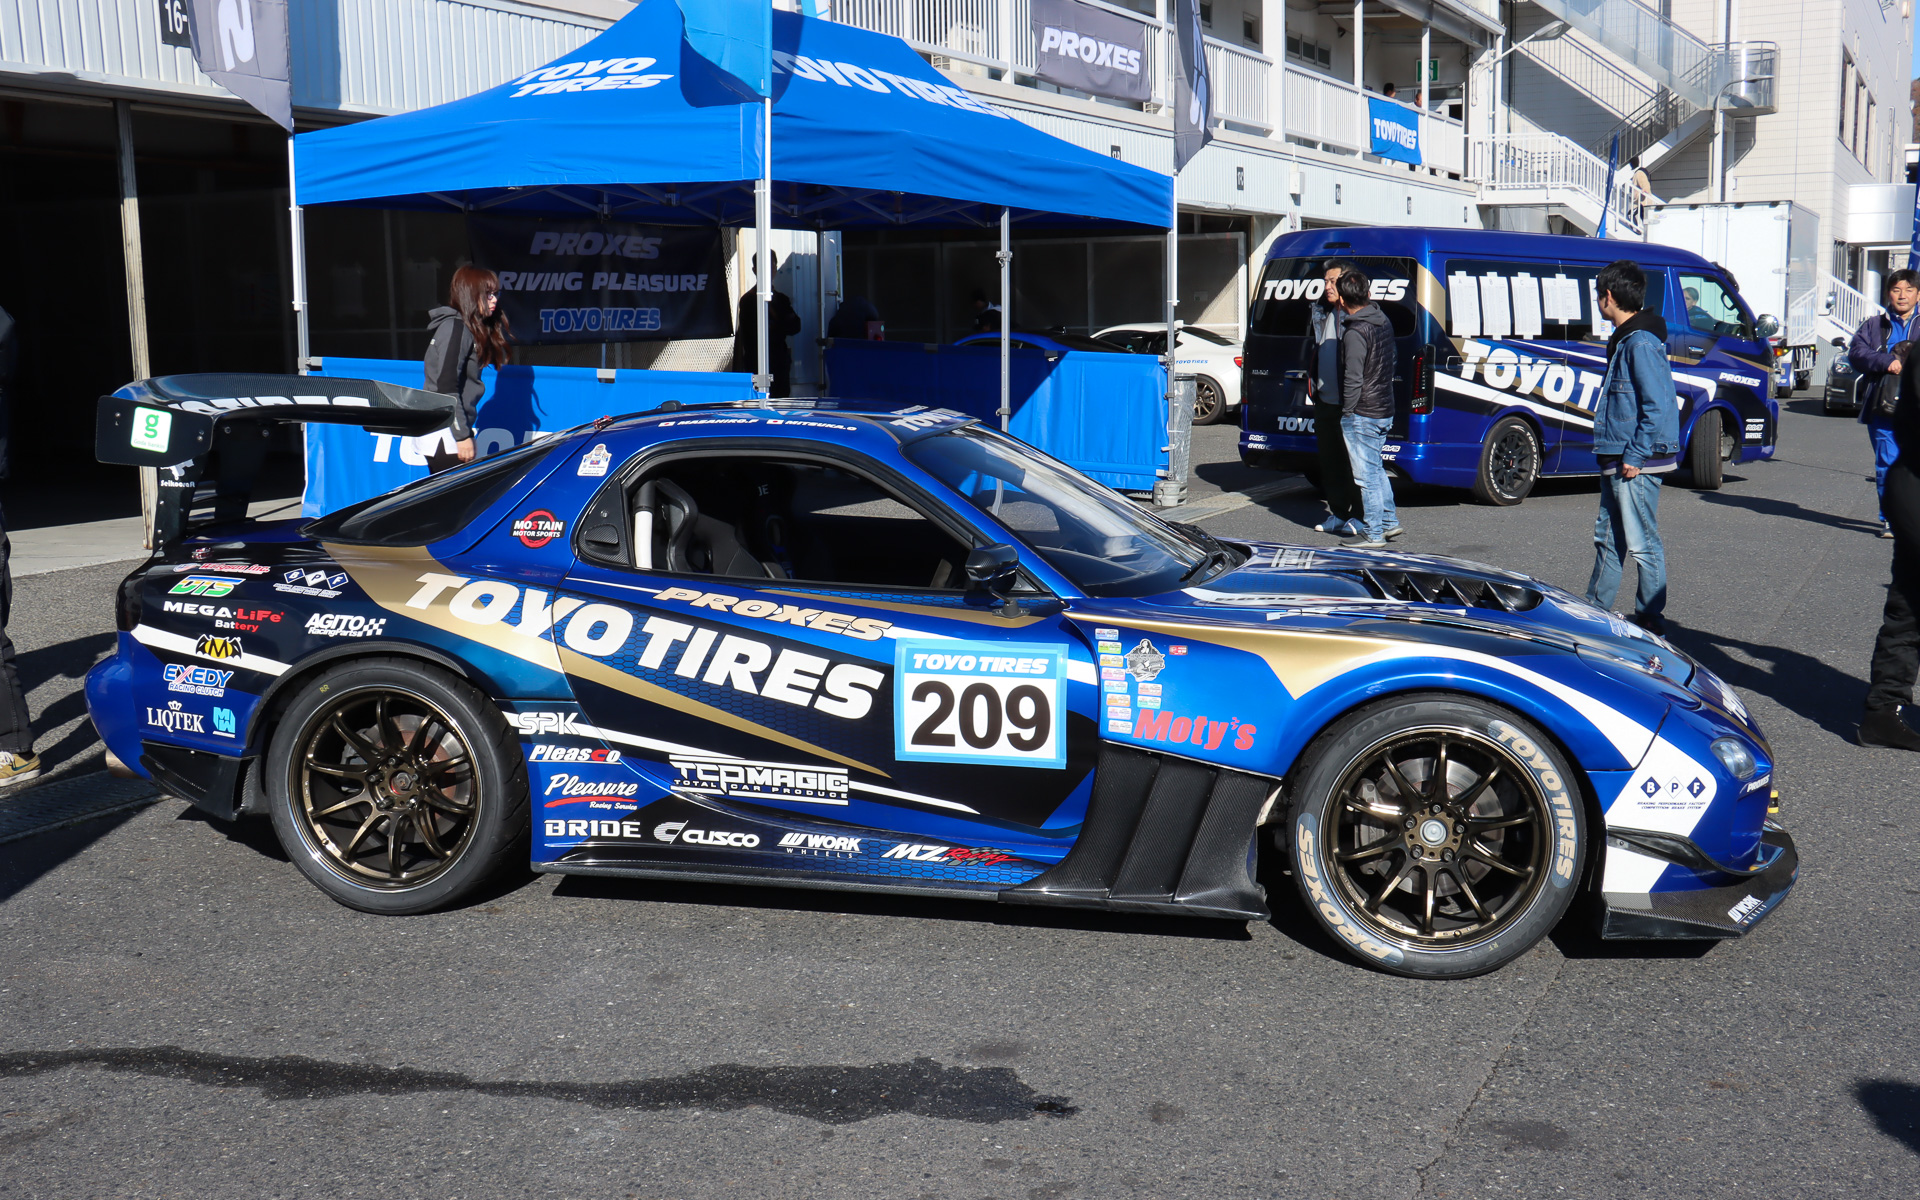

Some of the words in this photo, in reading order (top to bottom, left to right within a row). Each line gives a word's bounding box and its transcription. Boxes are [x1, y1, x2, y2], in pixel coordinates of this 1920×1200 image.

[1040, 26, 1141, 75] PROXES
[511, 57, 657, 86] TOYO
[509, 74, 675, 98] TIRES
[529, 231, 662, 259] PROXES
[498, 271, 584, 291] RIVING
[591, 272, 709, 292] PLEASURE
[1719, 372, 1761, 387] PROXES
[513, 520, 564, 530] MOSTAIN
[304, 613, 366, 631] AGITO
[653, 586, 895, 641] PROXES
[215, 619, 259, 633] Battery
[912, 654, 976, 672] TOYO
[977, 655, 1050, 674] TIRES
[163, 664, 234, 688] EXEDY
[168, 683, 195, 693] RACING
[196, 686, 224, 697] CLUTCH
[146, 707, 205, 733] LIQTEK
[518, 711, 581, 735] SPK
[910, 680, 1051, 752] 209
[1132, 708, 1257, 751] Moty's
[528, 744, 621, 763] Pleasco
[544, 773, 638, 796] Pleasure
[674, 779, 717, 788] TOTAL
[730, 783, 761, 792] CAR
[771, 787, 848, 799] PRODUCE
[589, 801, 612, 810] Racing
[614, 802, 637, 810] Service
[544, 820, 641, 838] BRIDE
[787, 847, 853, 859] WHEELS
[807, 835, 862, 851] WORK
[1298, 825, 1394, 959] PROXES
